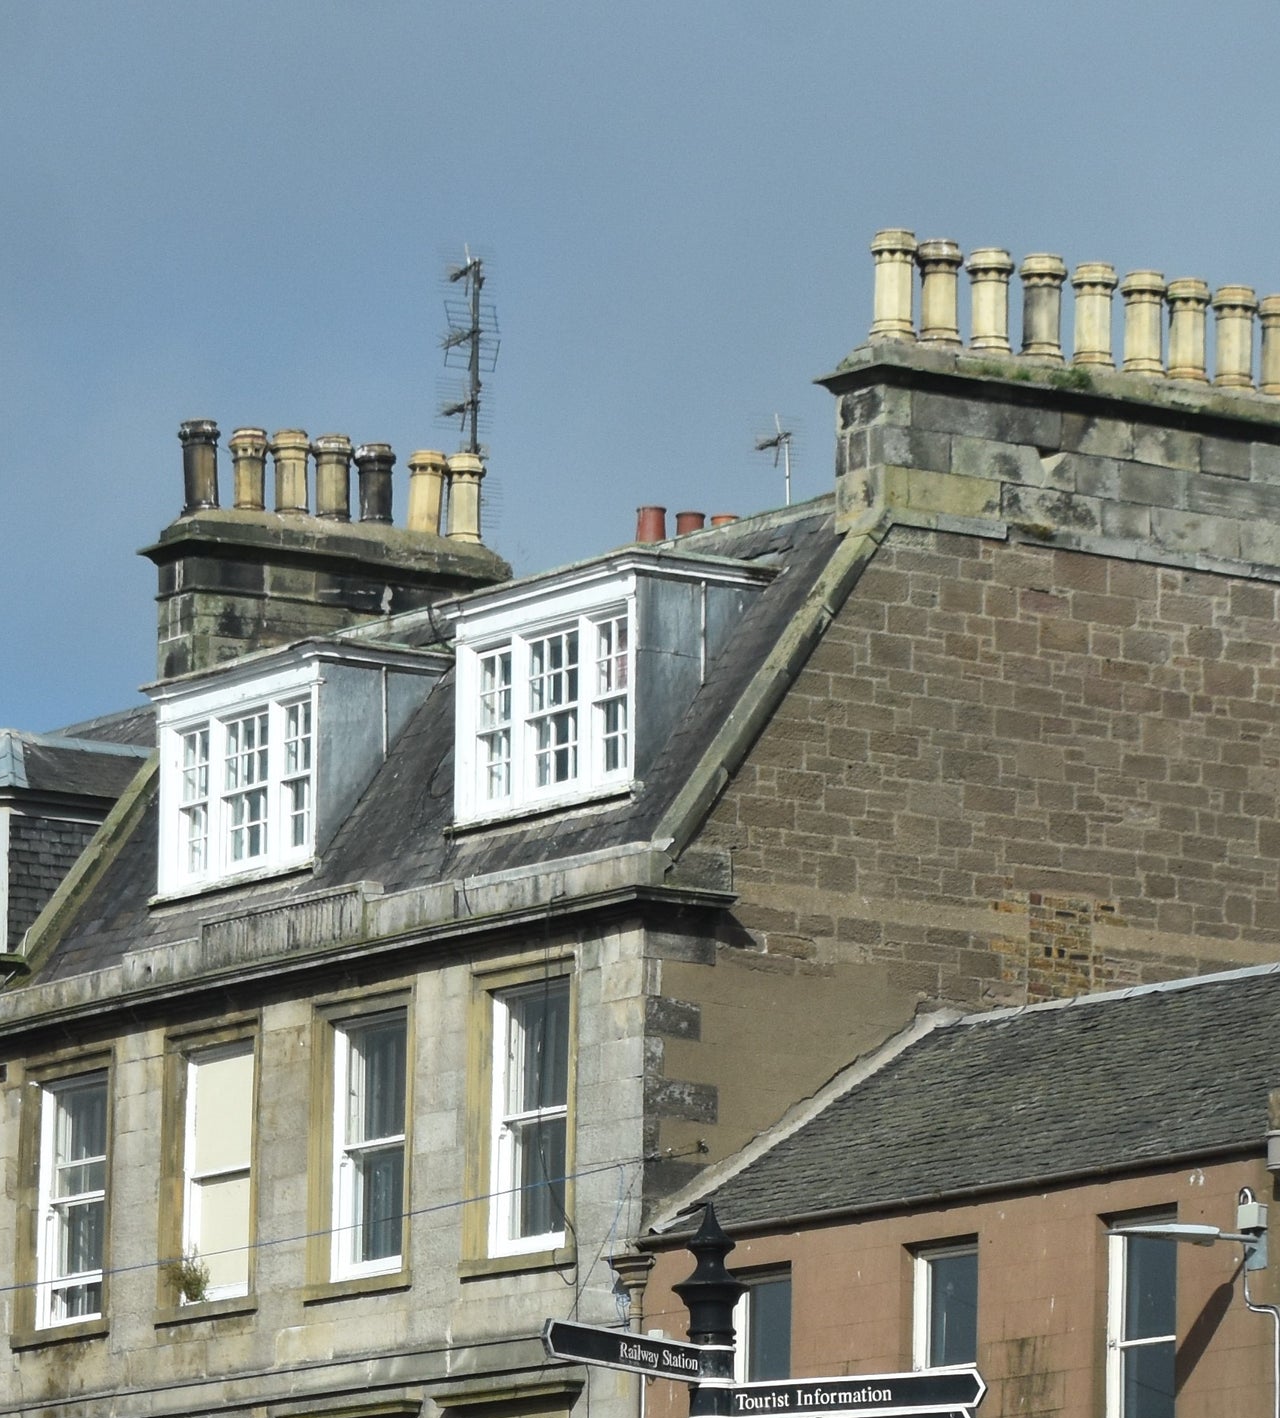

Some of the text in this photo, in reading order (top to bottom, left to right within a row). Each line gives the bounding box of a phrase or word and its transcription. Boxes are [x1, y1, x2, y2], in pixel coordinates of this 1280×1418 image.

[620, 1342, 698, 1371] Railway Station
[736, 1386, 892, 1410] Tourist Information
